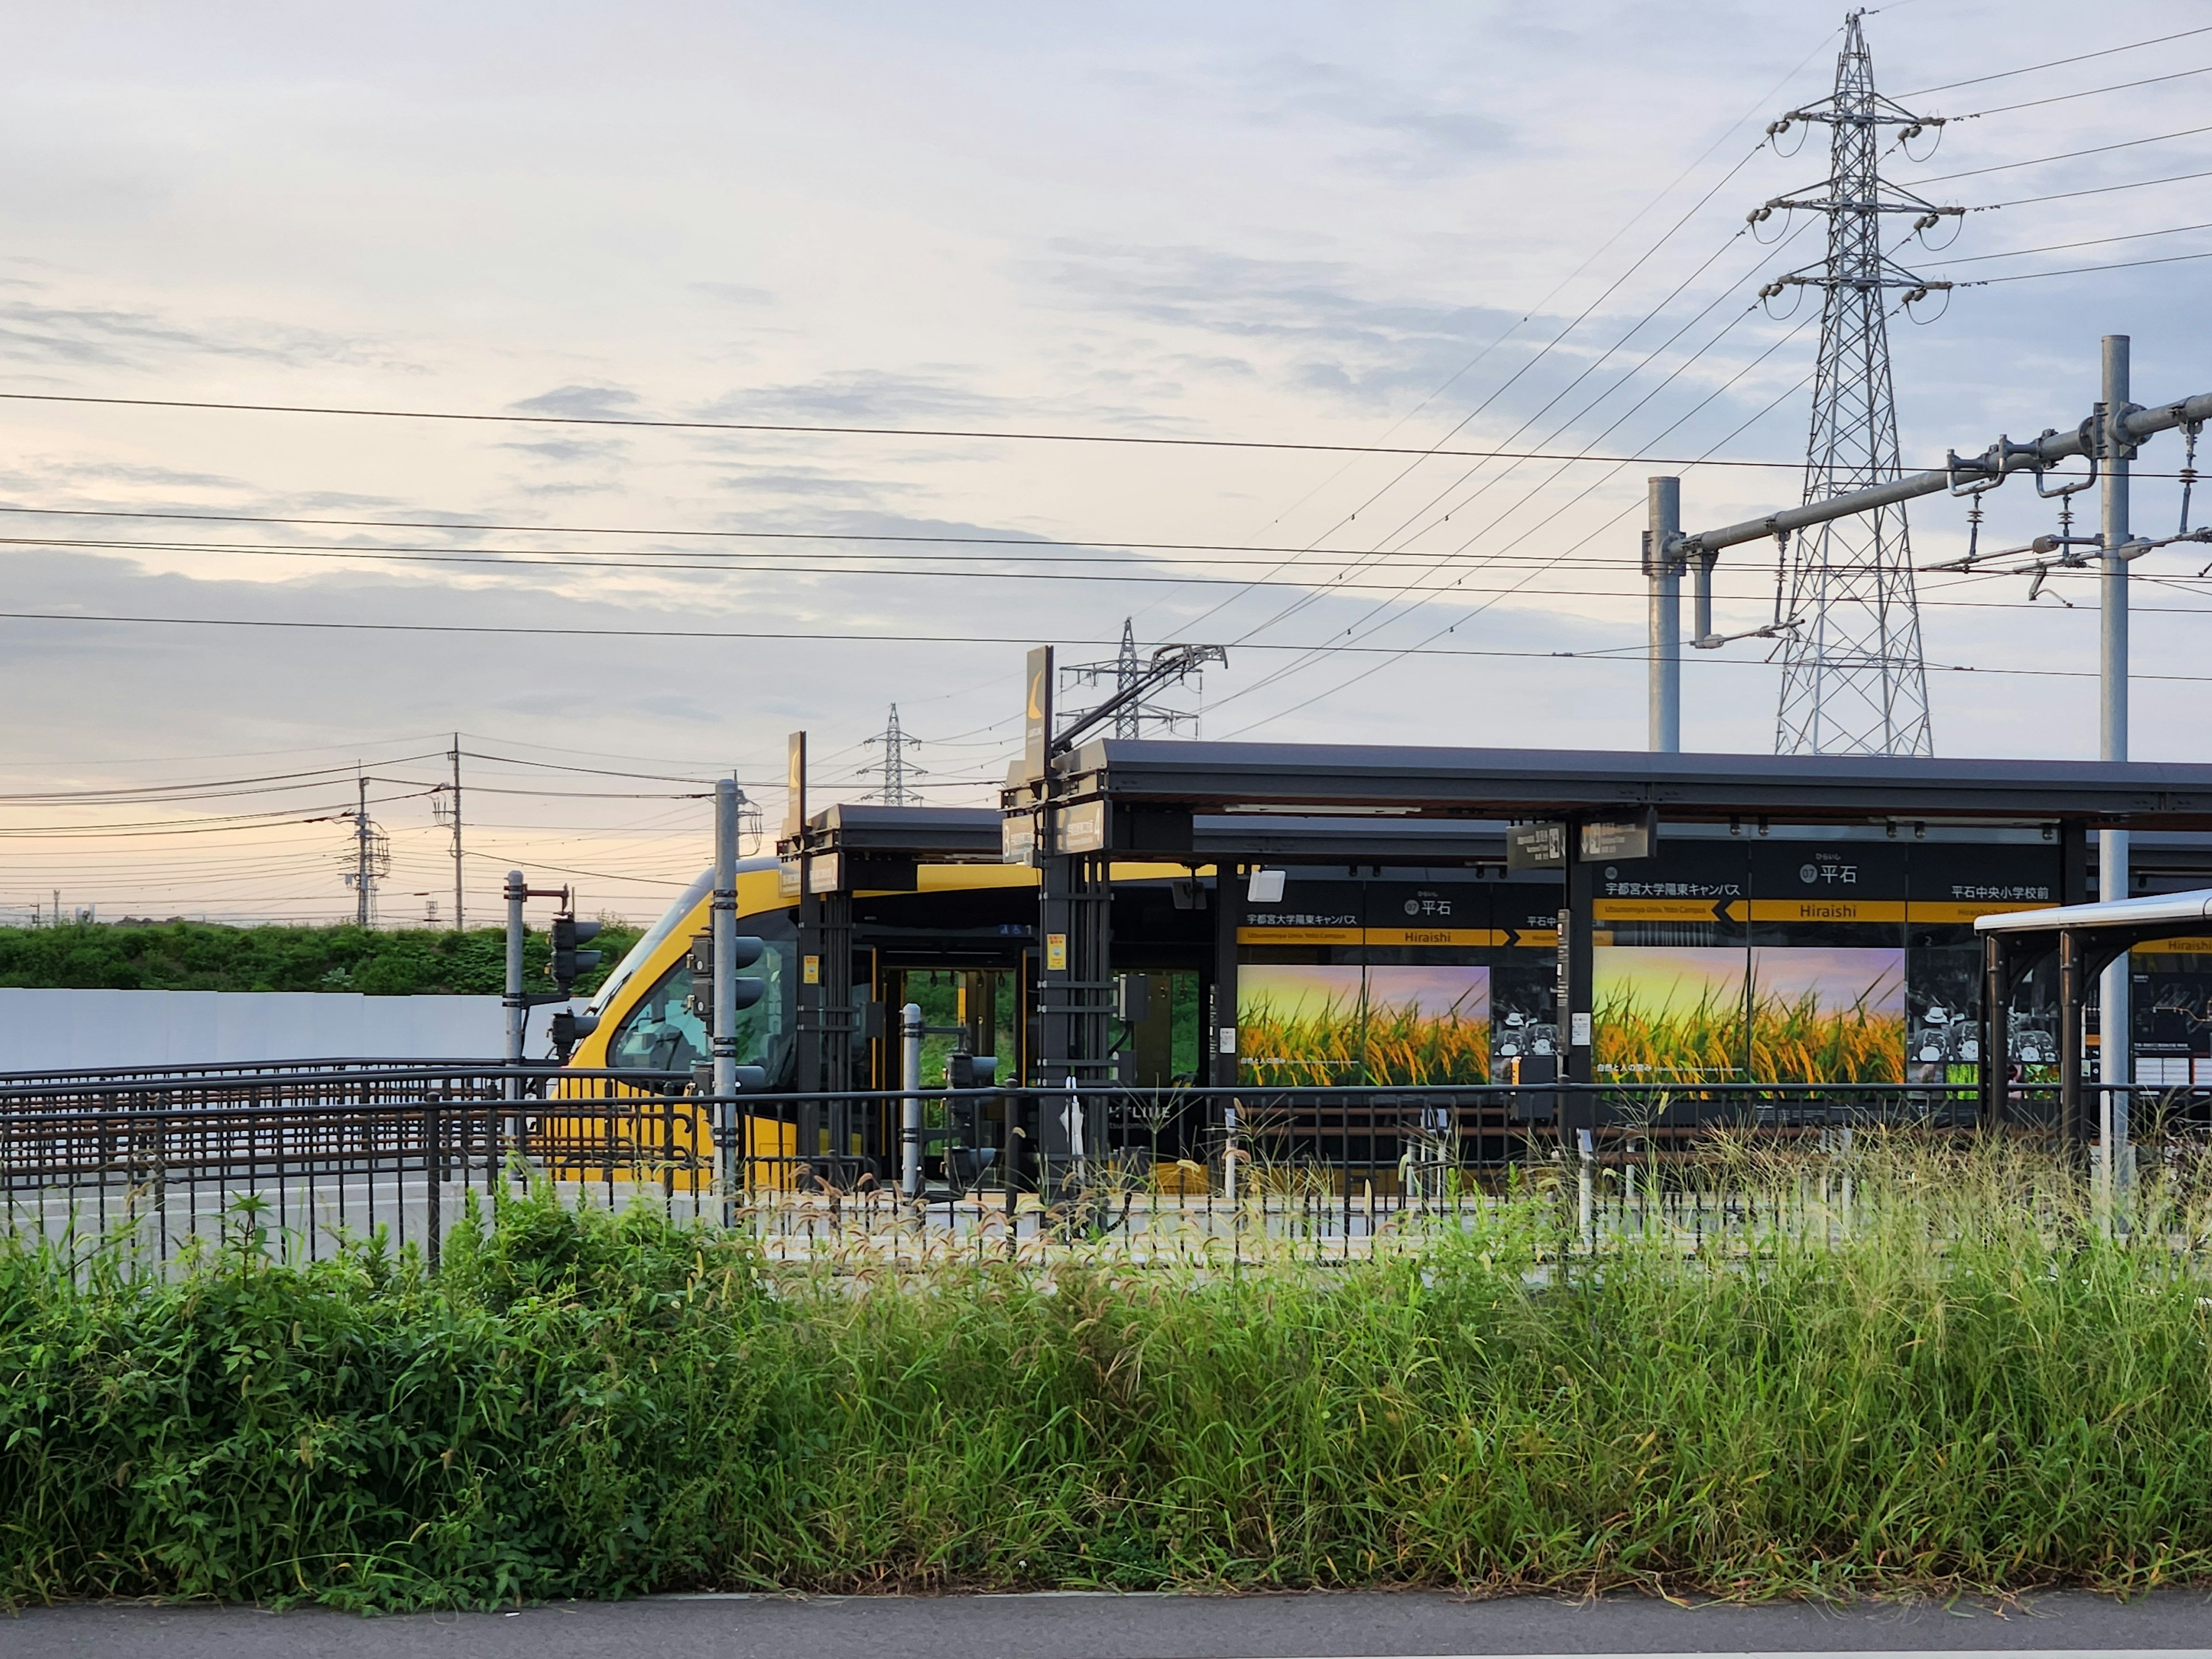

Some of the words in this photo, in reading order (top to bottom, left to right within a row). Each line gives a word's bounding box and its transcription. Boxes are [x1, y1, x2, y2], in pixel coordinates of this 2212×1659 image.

[1802, 869, 1815, 878] 07
[1820, 865, 1858, 884] 平石
[1605, 883, 1741, 895] 宇都宮大学陽東キャンパス
[1951, 885, 2049, 899] 平石中央小学校前
[1421, 900, 1452, 915] 平石
[1800, 904, 1857, 918] Hiraishi
[1405, 931, 1451, 942] Hiraishi
[2168, 940, 2212, 950] Hiraishi
